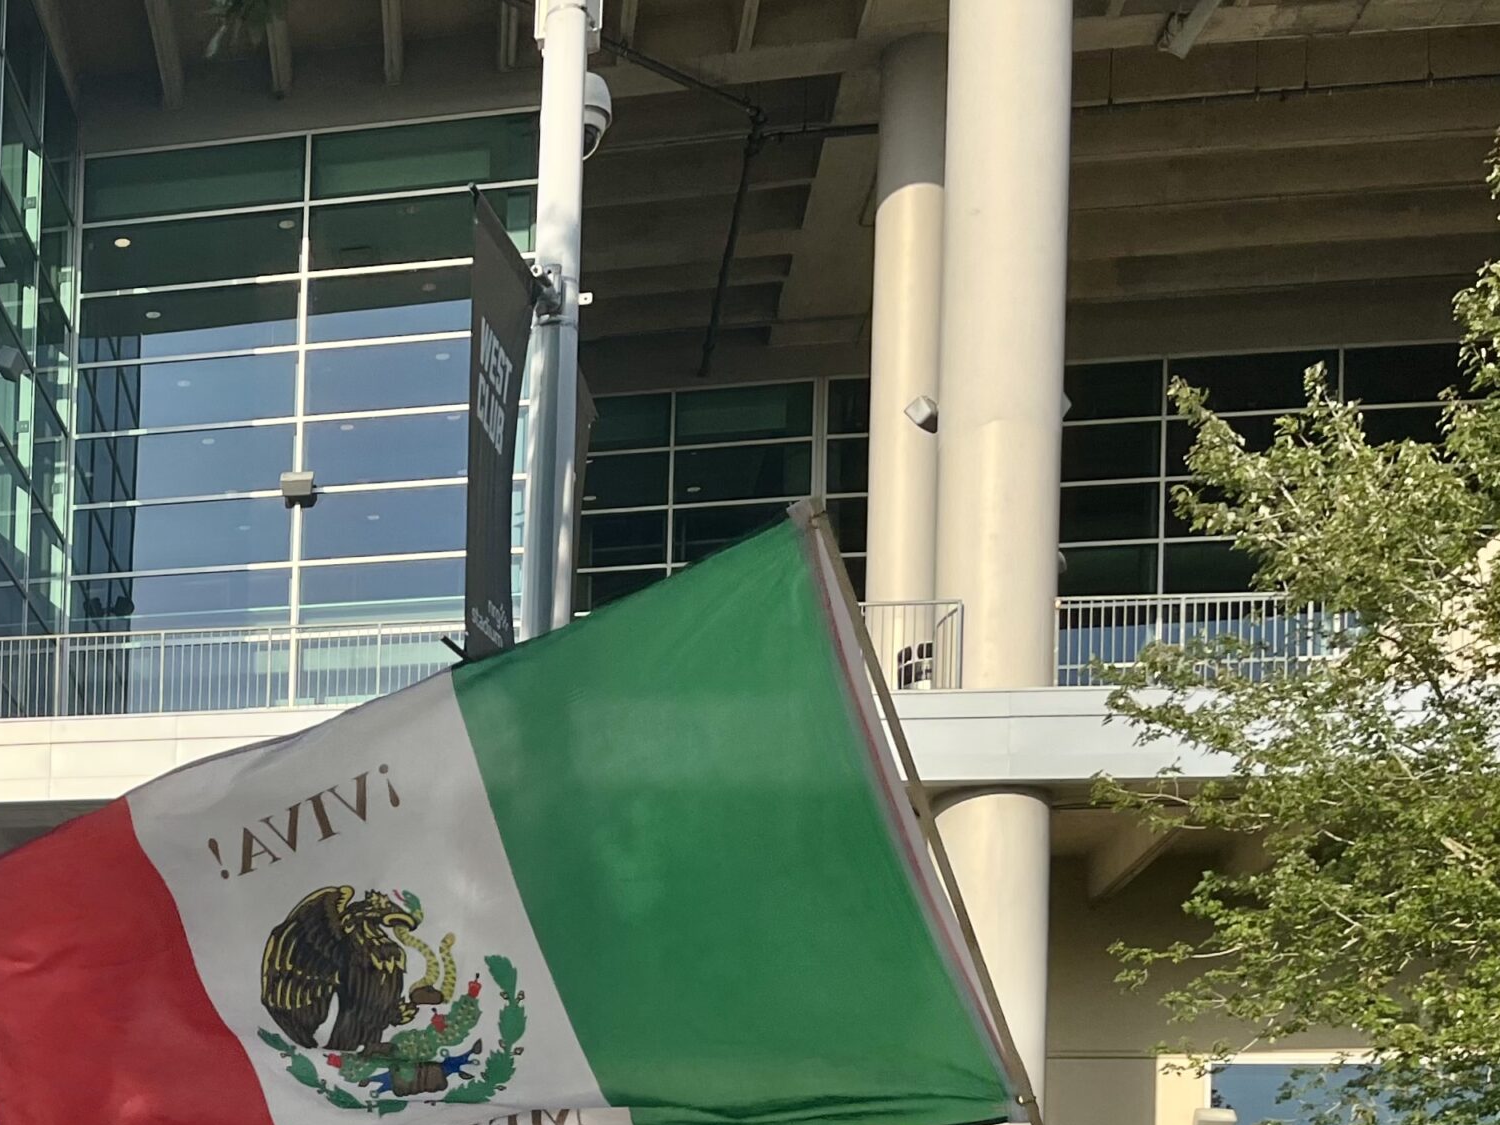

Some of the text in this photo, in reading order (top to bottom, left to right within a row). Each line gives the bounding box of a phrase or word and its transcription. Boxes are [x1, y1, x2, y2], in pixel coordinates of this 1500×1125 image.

[480, 315, 513, 404] WEST
[477, 371, 505, 455] CLUB
[471, 607, 503, 648] stadium
